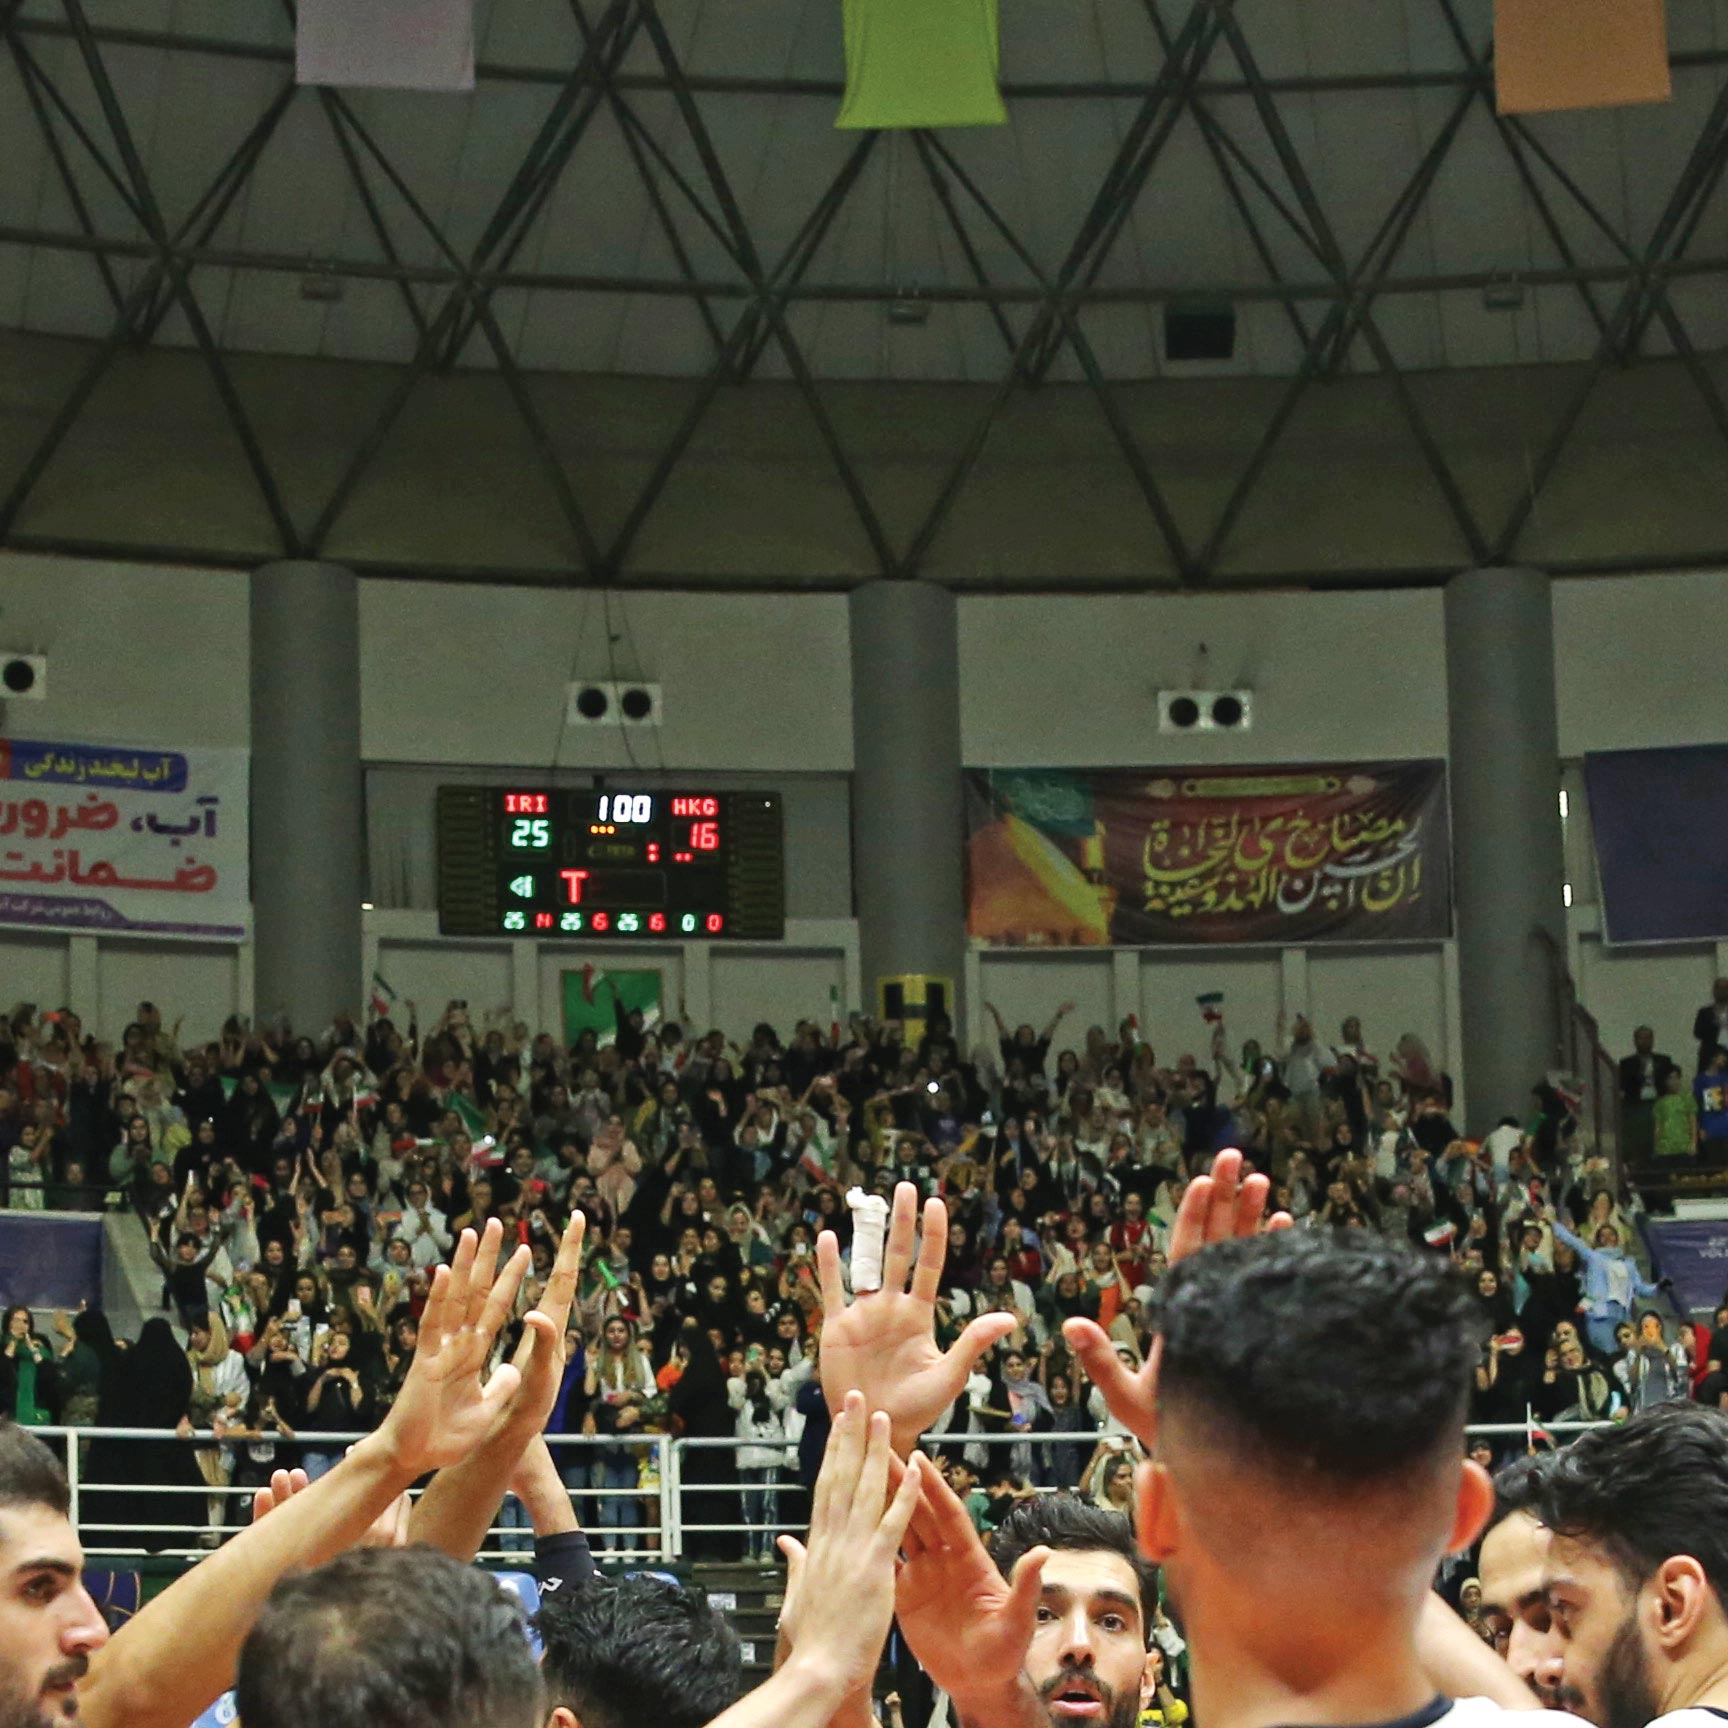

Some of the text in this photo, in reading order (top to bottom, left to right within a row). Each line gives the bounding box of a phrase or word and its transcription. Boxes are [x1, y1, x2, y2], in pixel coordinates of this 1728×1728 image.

[504, 794, 548, 813] IRI
[598, 794, 651, 823] 100
[672, 798, 719, 816] HKG
[511, 819, 549, 847] 25
[689, 822, 720, 850] 16
[559, 868, 589, 904] T
[706, 913, 723, 932] 0
